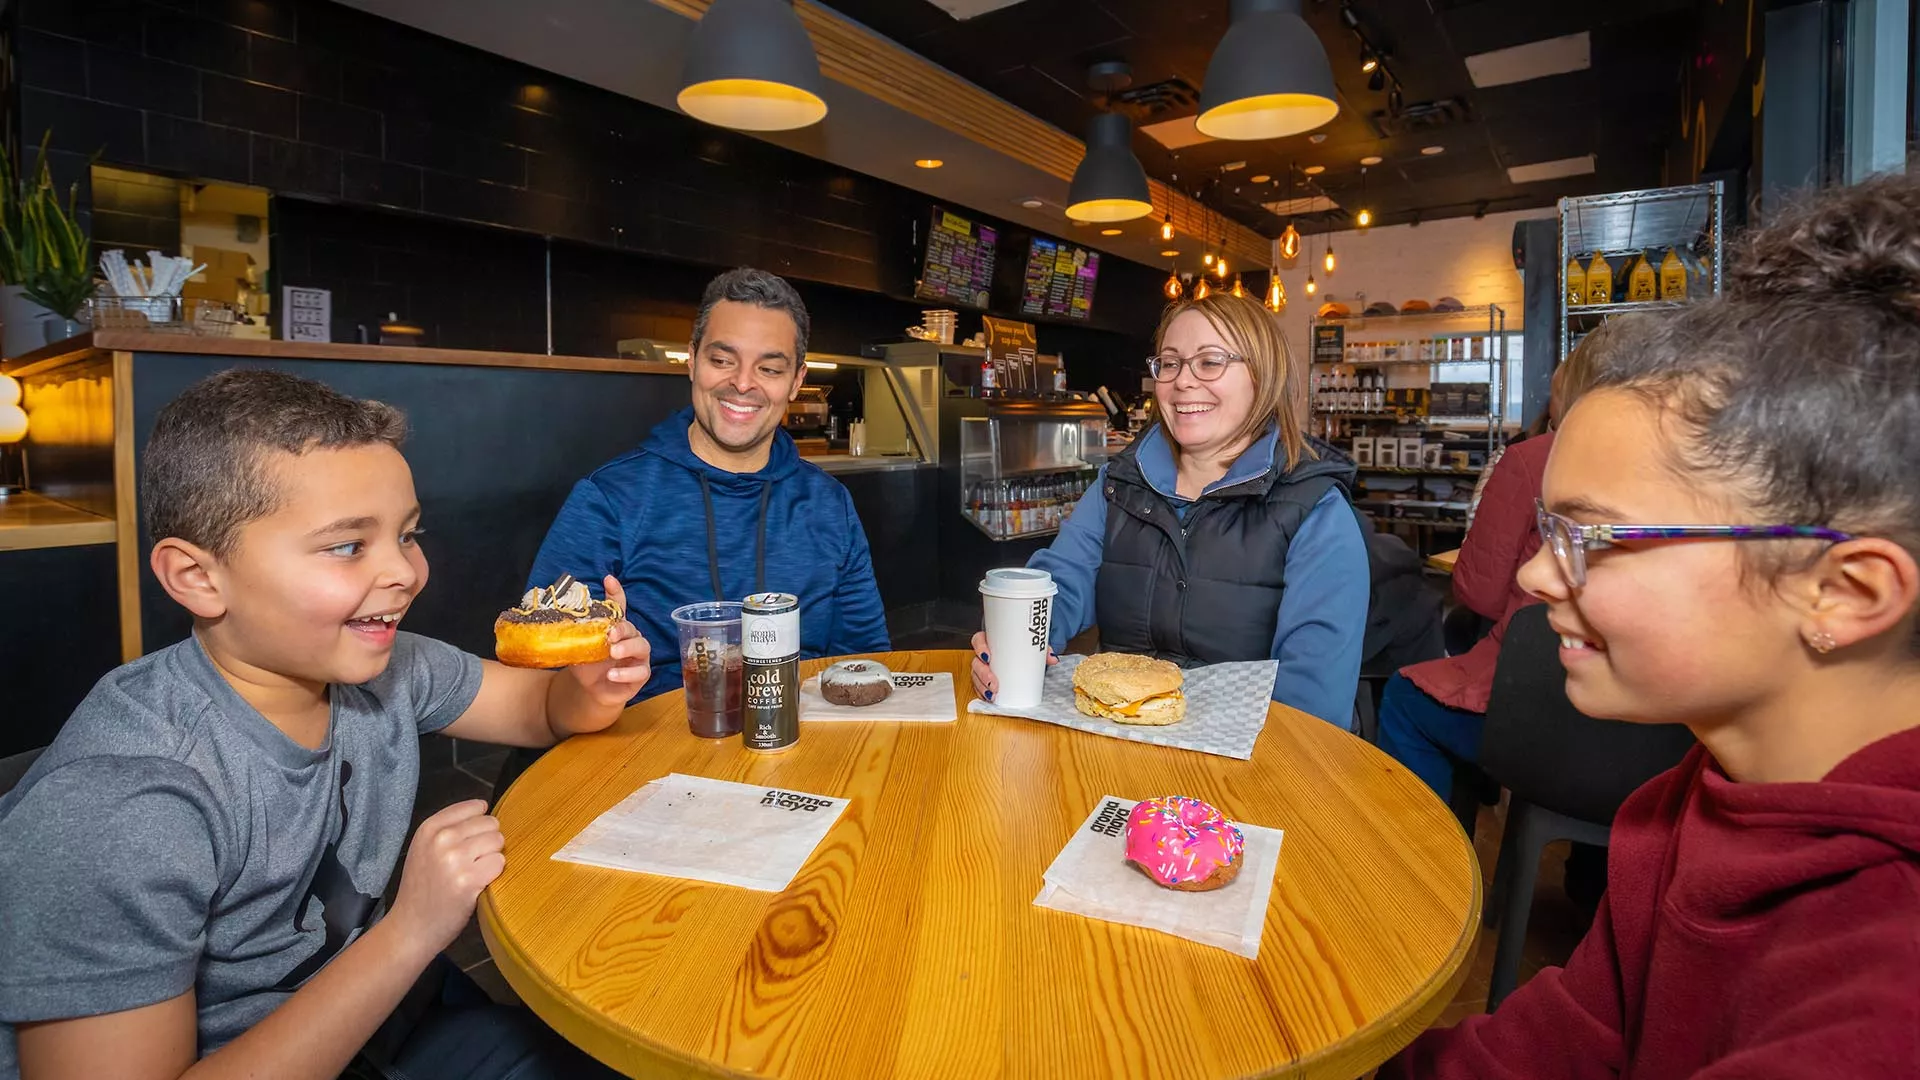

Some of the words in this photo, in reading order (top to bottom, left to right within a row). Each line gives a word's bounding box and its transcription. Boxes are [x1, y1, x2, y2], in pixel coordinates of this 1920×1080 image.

[1029, 600, 1041, 646] maya
[1040, 598, 1048, 651] aroma
[750, 635, 776, 645] maya
[750, 669, 780, 684] cold
[747, 680, 784, 697] brew
[760, 797, 819, 811] maya
[766, 790, 834, 807] aroma
[1090, 801, 1120, 832] aroma
[1104, 808, 1131, 837] maya
